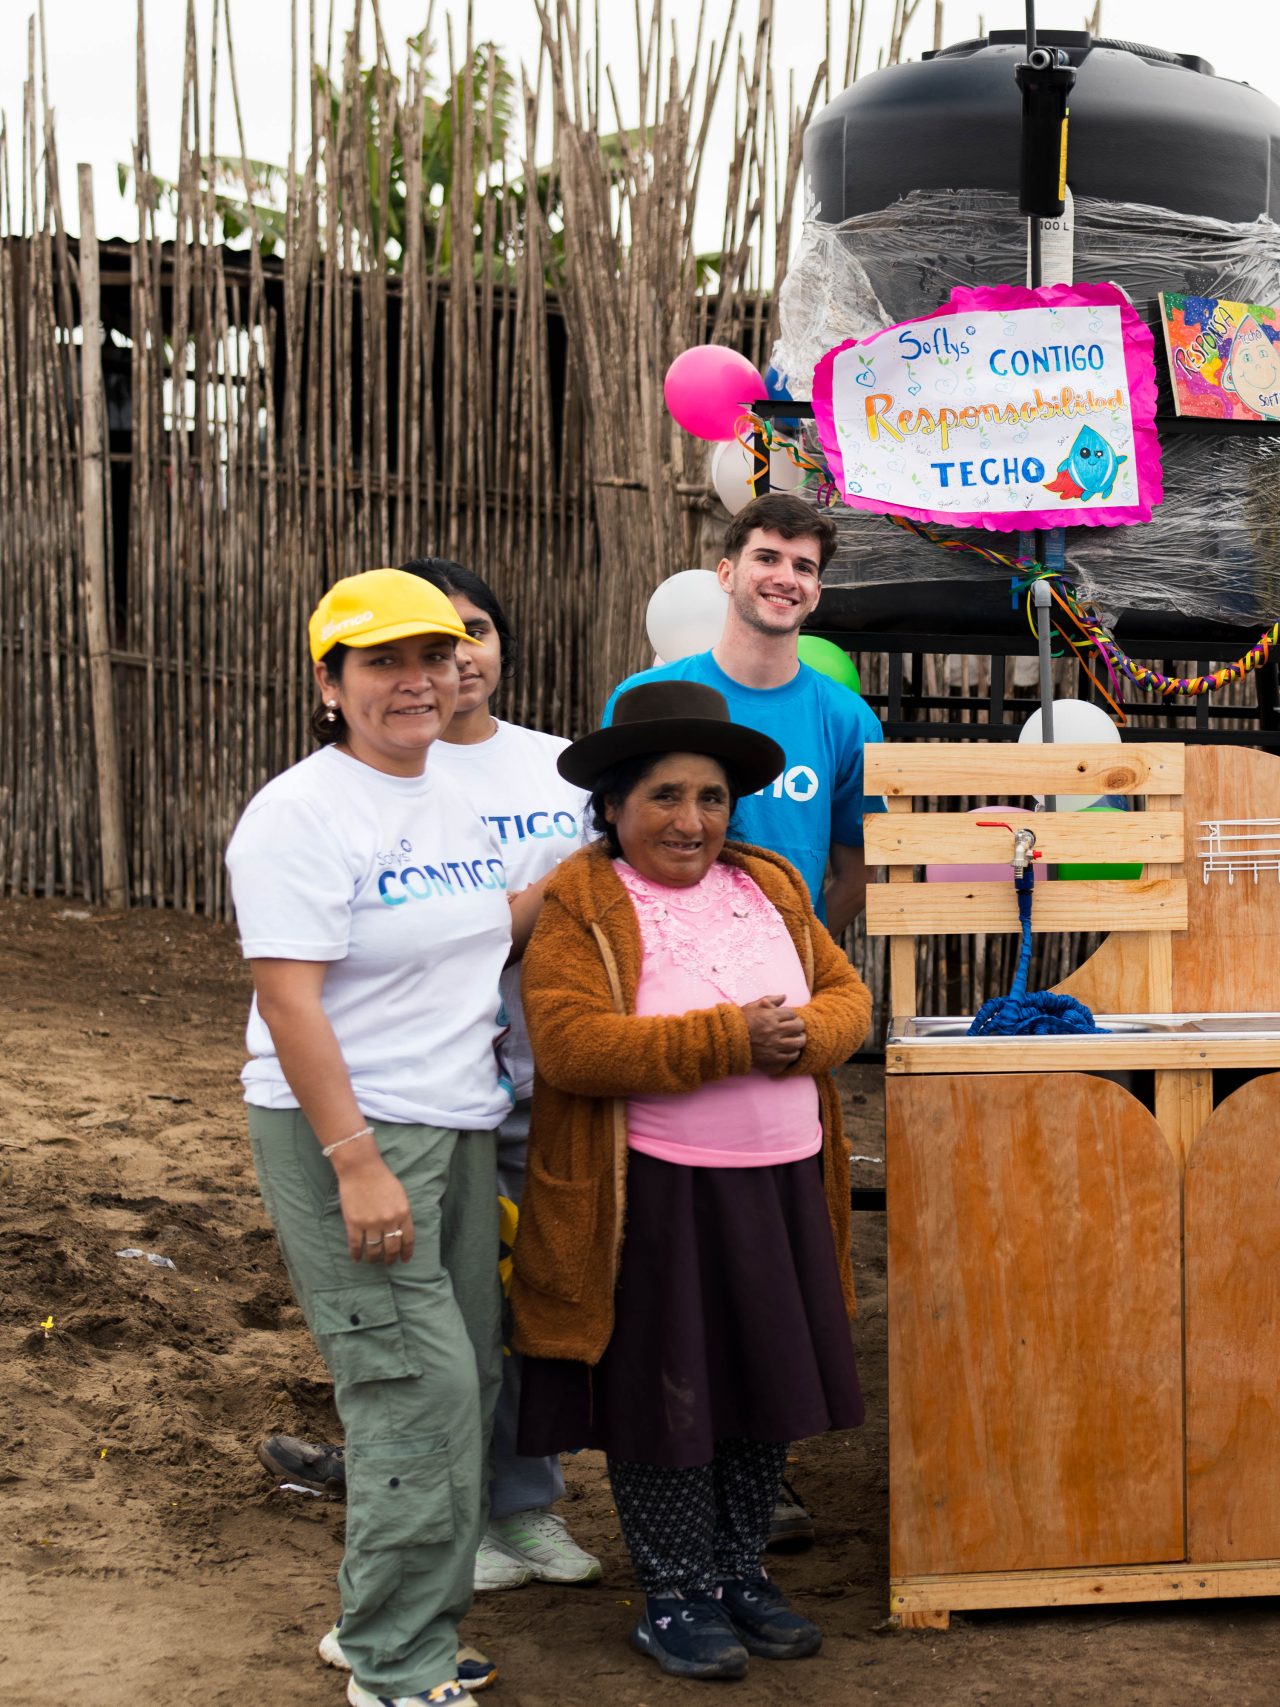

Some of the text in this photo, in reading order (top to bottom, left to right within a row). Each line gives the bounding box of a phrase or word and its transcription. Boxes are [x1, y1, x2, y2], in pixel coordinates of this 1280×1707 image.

[1040, 221, 1070, 231] 100 L
[899, 327, 1104, 377] Softys CONTIGO
[864, 387, 1129, 451] Responsabilidad
[930, 457, 1045, 488] TECHO
[481, 811, 577, 845] TIGO
[378, 858, 507, 906] CONTIGO
